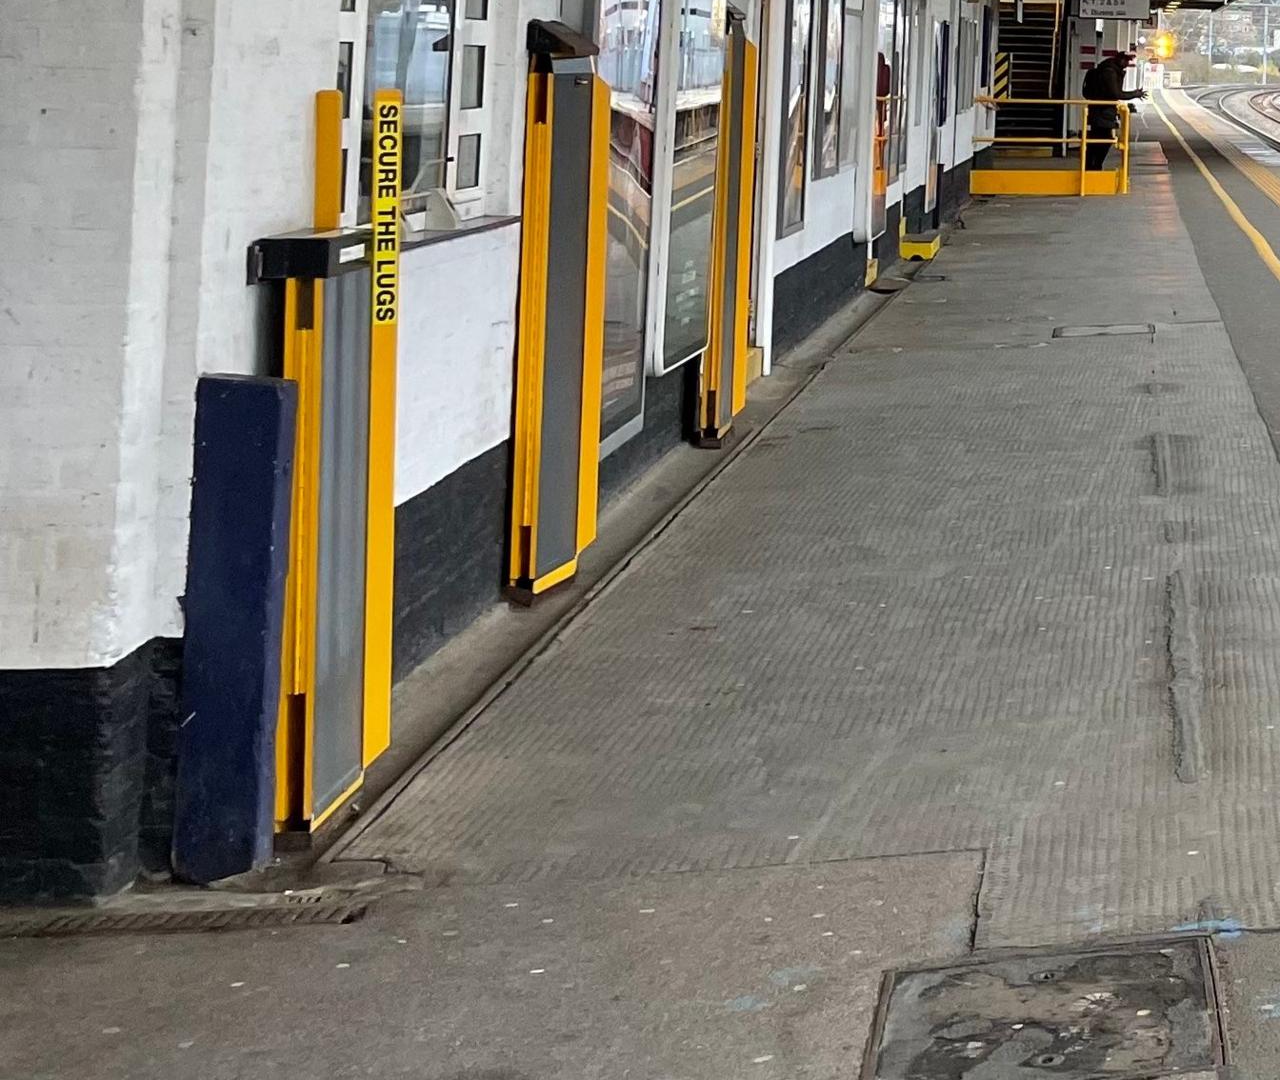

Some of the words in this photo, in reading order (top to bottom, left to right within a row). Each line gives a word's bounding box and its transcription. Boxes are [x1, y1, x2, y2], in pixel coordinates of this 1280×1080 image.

[378, 104, 399, 199] SECURE
[376, 206, 397, 252] THE
[375, 260, 396, 322] LUGS
